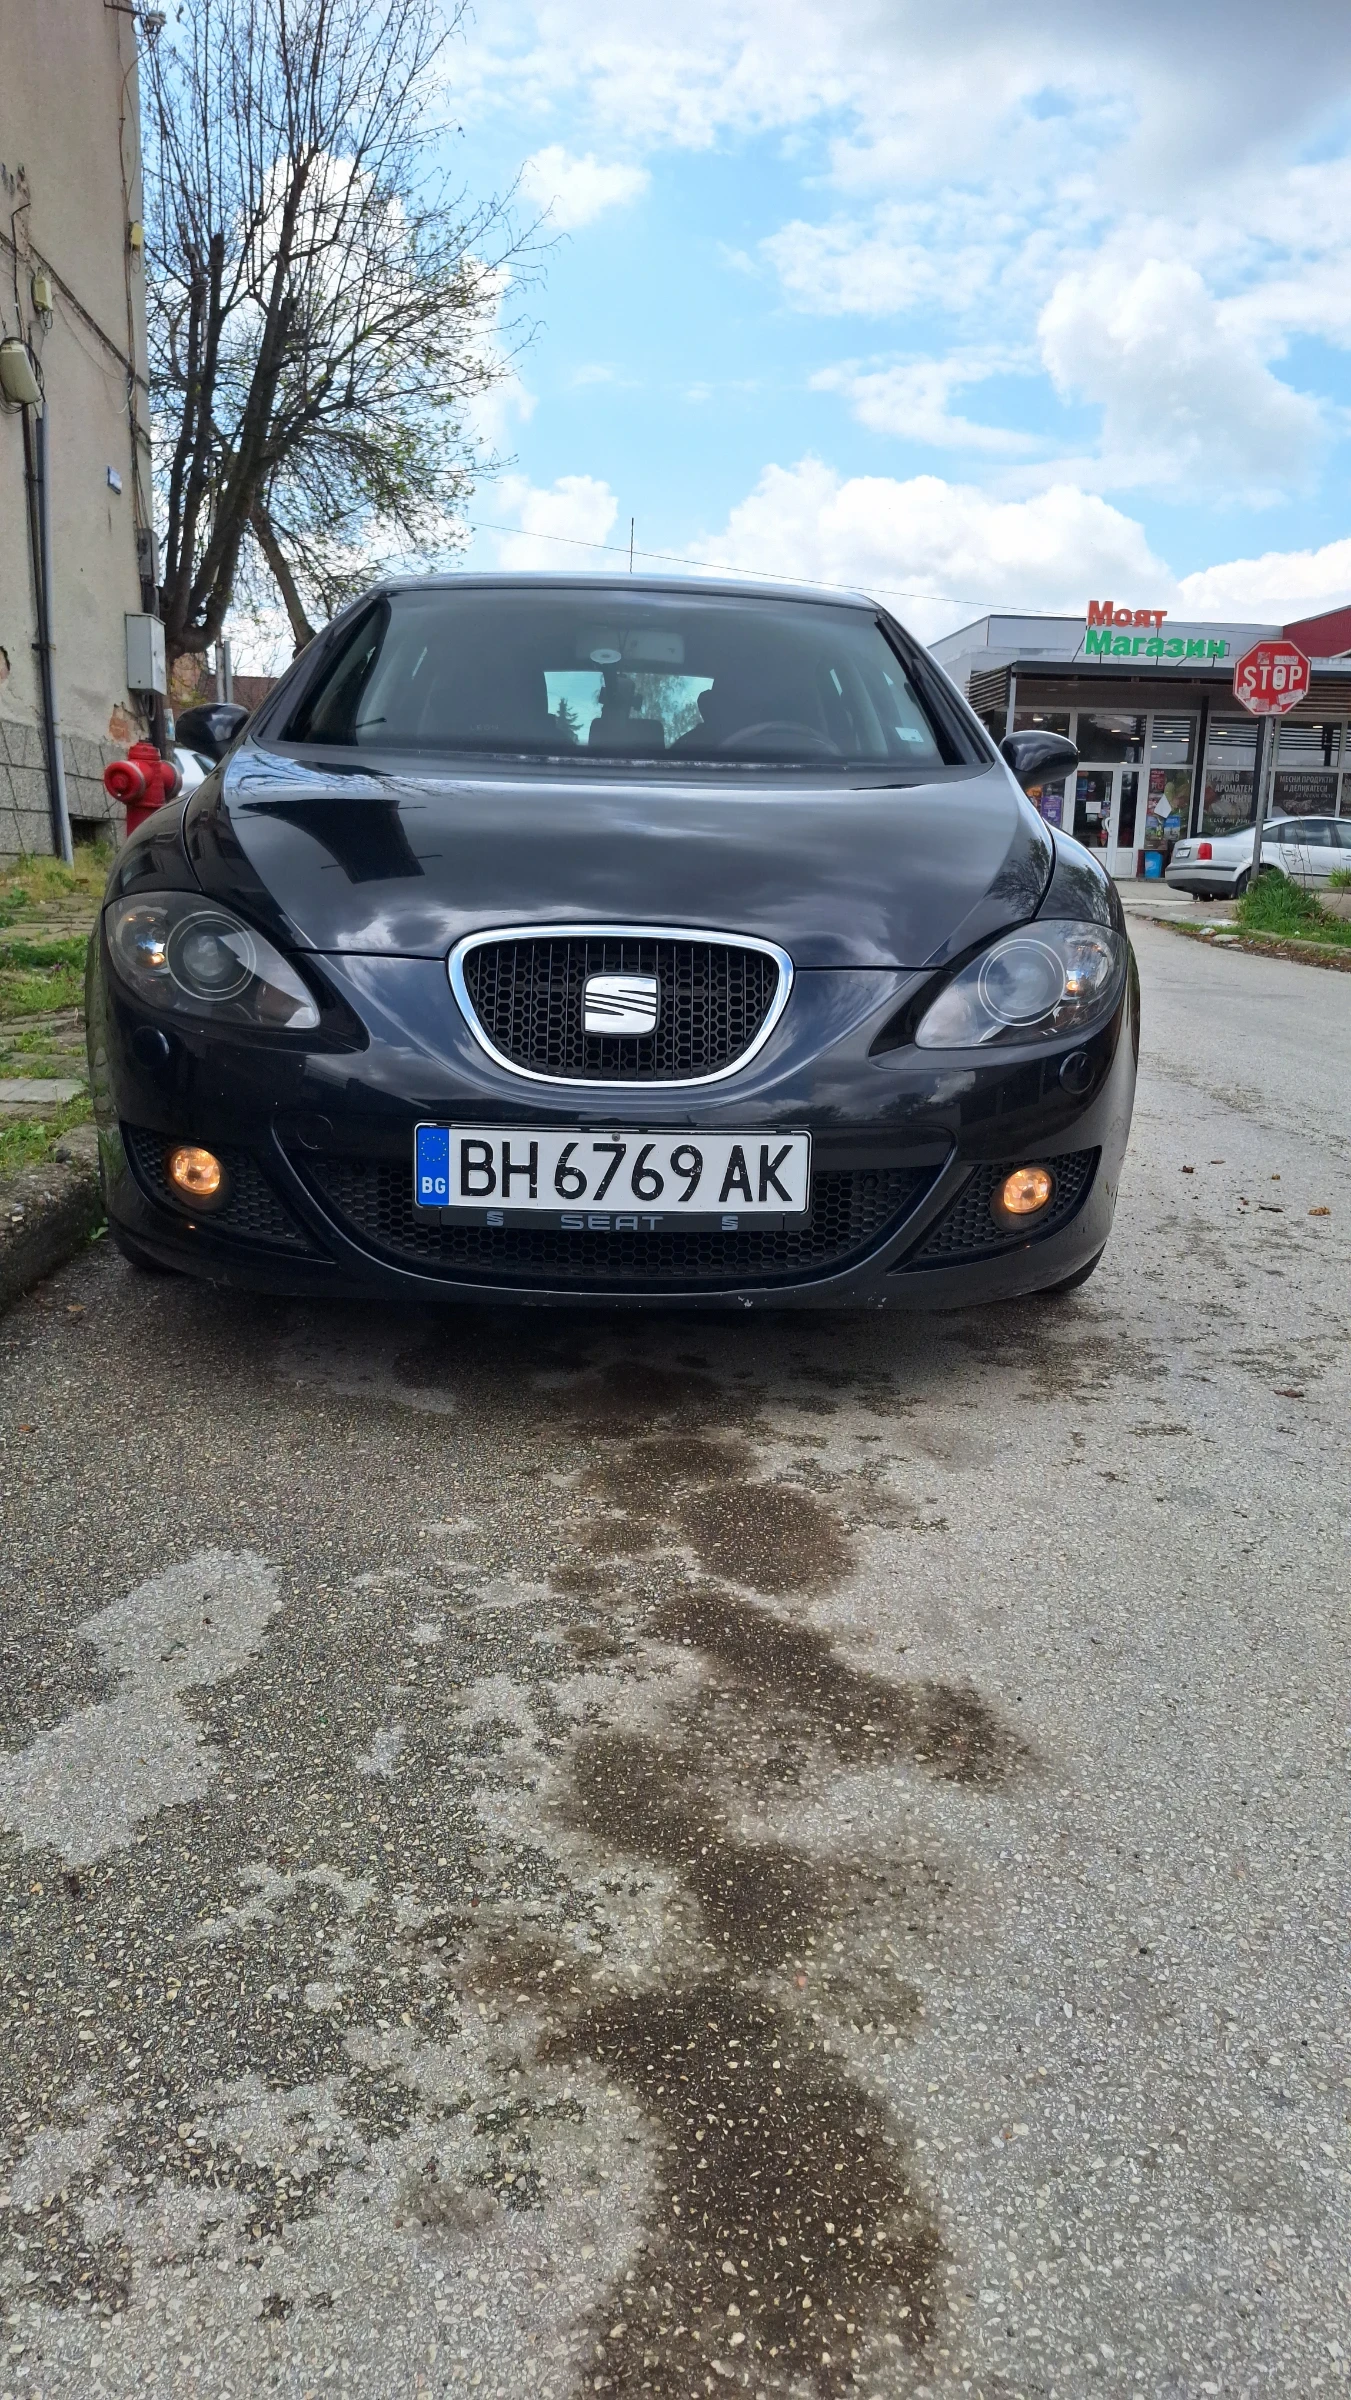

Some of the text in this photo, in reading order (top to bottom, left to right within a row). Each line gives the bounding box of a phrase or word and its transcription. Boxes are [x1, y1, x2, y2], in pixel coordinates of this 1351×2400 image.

[1087, 600, 1168, 629] Моят
[1085, 629, 1225, 659] Магазин
[1243, 665, 1303, 691] STOP
[1215, 784, 1253, 793] АРОМАТЕН
[1279, 775, 1300, 783] МЕСНИ
[1302, 776, 1334, 784] ПРОДУКТИ
[421, 1138, 793, 1202] BG BH 6769 AK
[560, 1214, 664, 1231] SEAT
